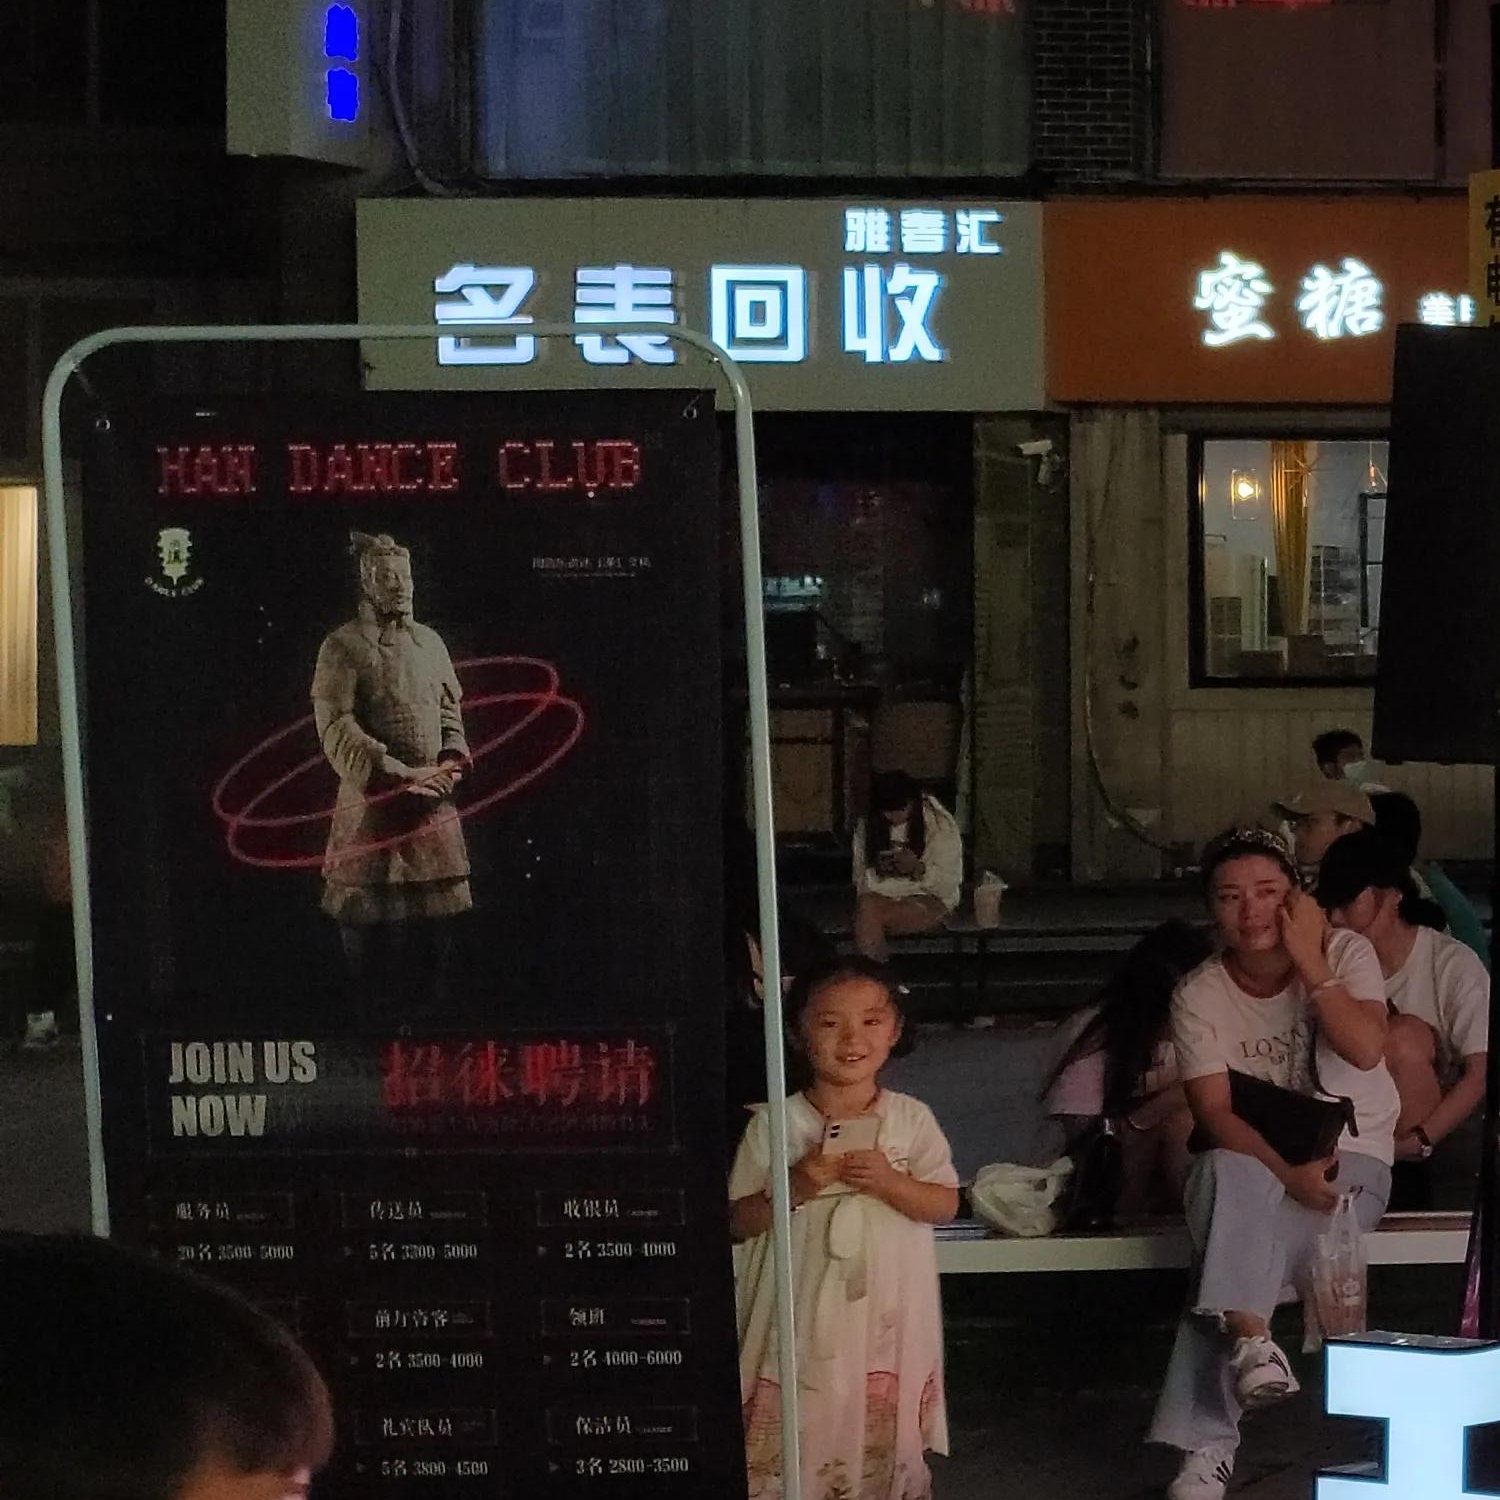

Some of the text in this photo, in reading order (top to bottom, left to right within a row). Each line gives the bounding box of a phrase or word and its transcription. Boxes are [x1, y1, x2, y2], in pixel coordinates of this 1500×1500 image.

[433, 261, 950, 368] 名表回收
[1193, 252, 1387, 348] 蜜糖
[498, 439, 642, 491] CLUB
[168, 1039, 318, 1086] JOIN US
[170, 1093, 268, 1137] NOW
